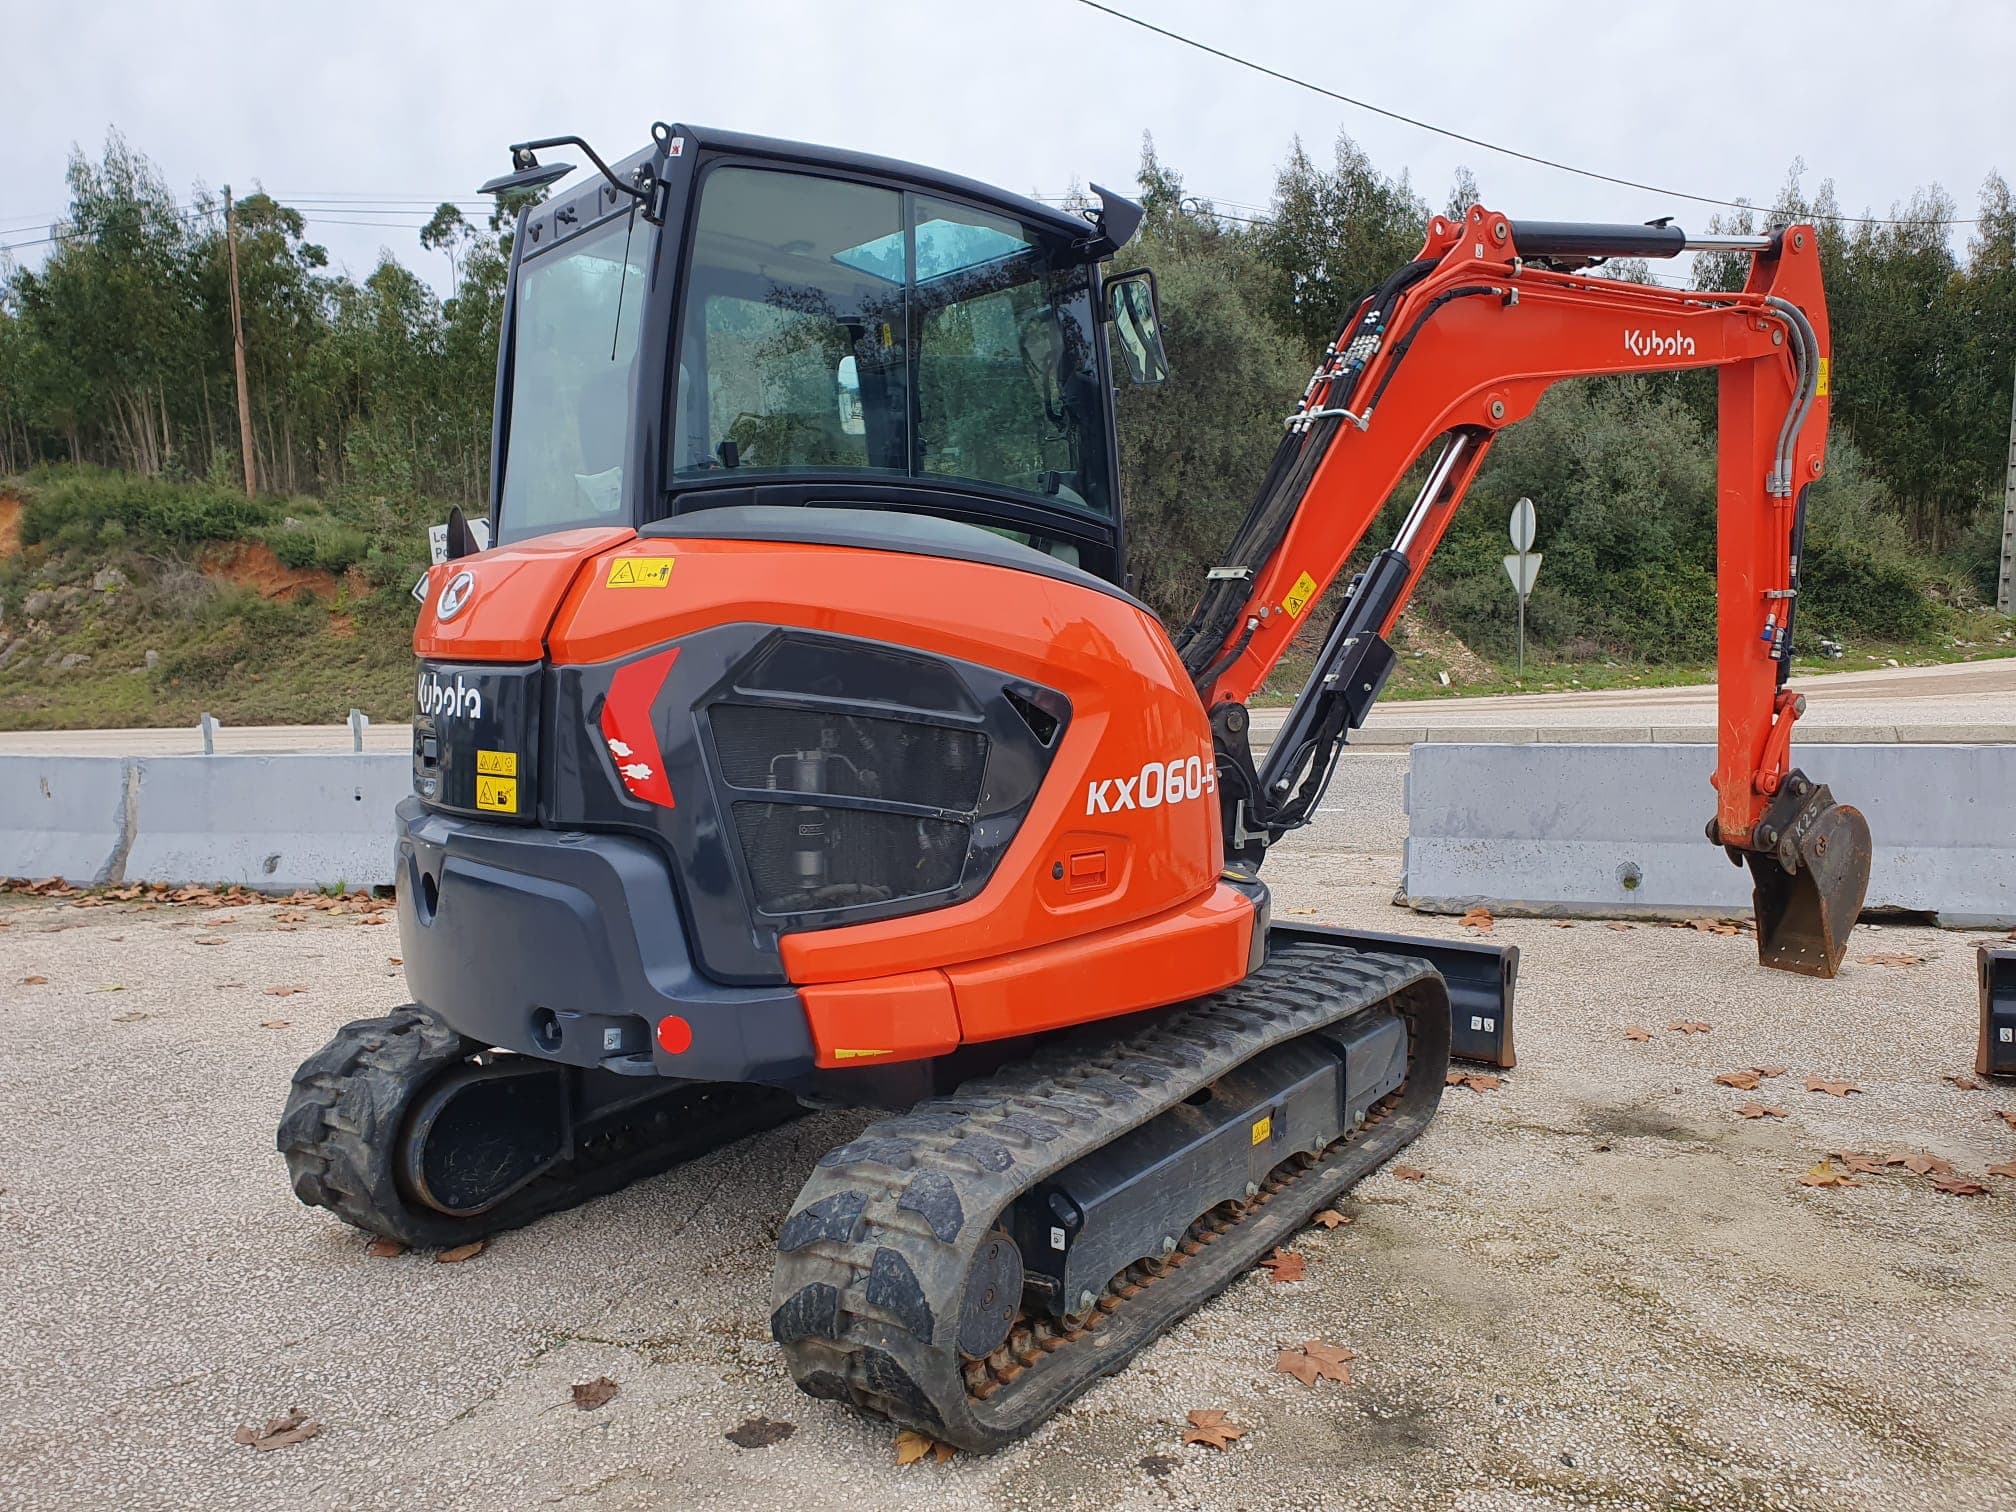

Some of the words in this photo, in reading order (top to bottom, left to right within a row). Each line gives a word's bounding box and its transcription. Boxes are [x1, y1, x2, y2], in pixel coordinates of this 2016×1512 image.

[1624, 329, 1695, 356] Kubota
[417, 671, 481, 719] Kubota
[1085, 755, 1215, 816] KX060-5
